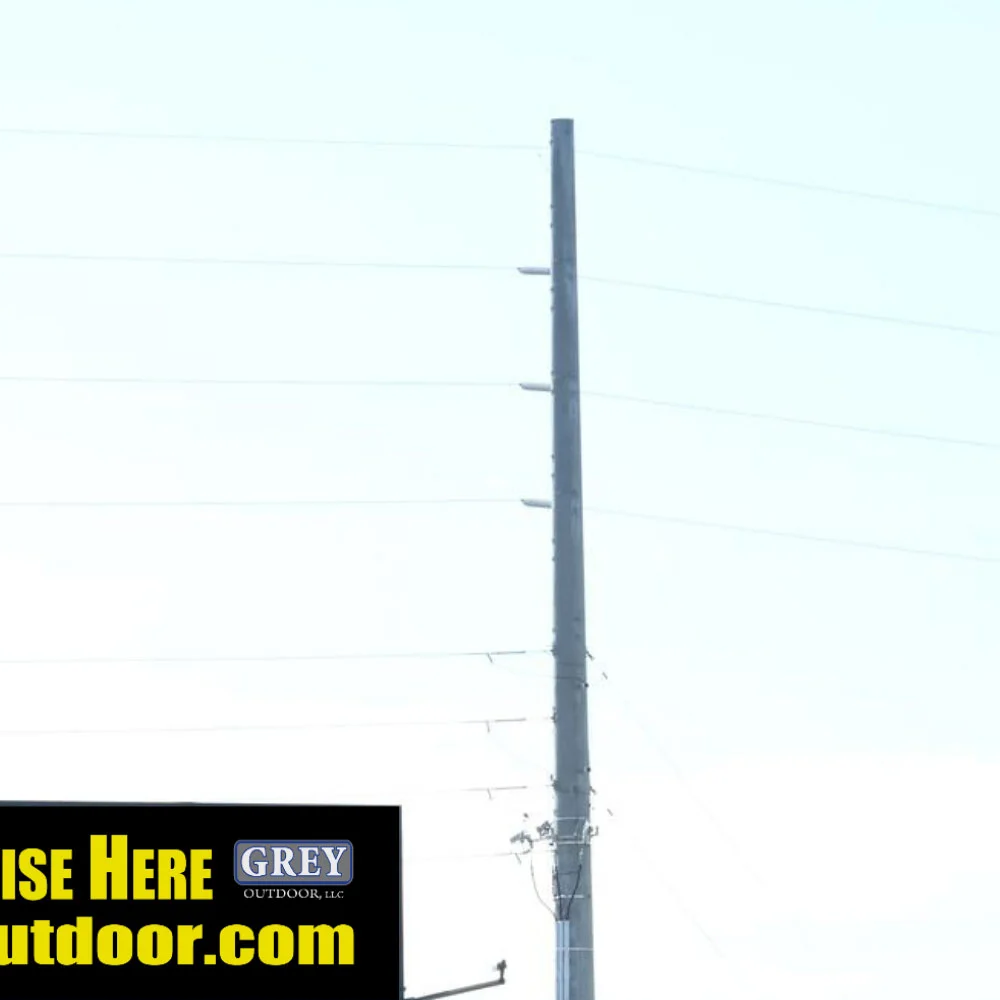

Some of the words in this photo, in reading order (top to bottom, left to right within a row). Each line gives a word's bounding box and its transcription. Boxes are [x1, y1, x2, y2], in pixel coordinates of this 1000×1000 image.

[241, 846, 347, 877] GREY
[243, 888, 322, 900] OUTDOOR,
[325, 891, 345, 899] LLC
